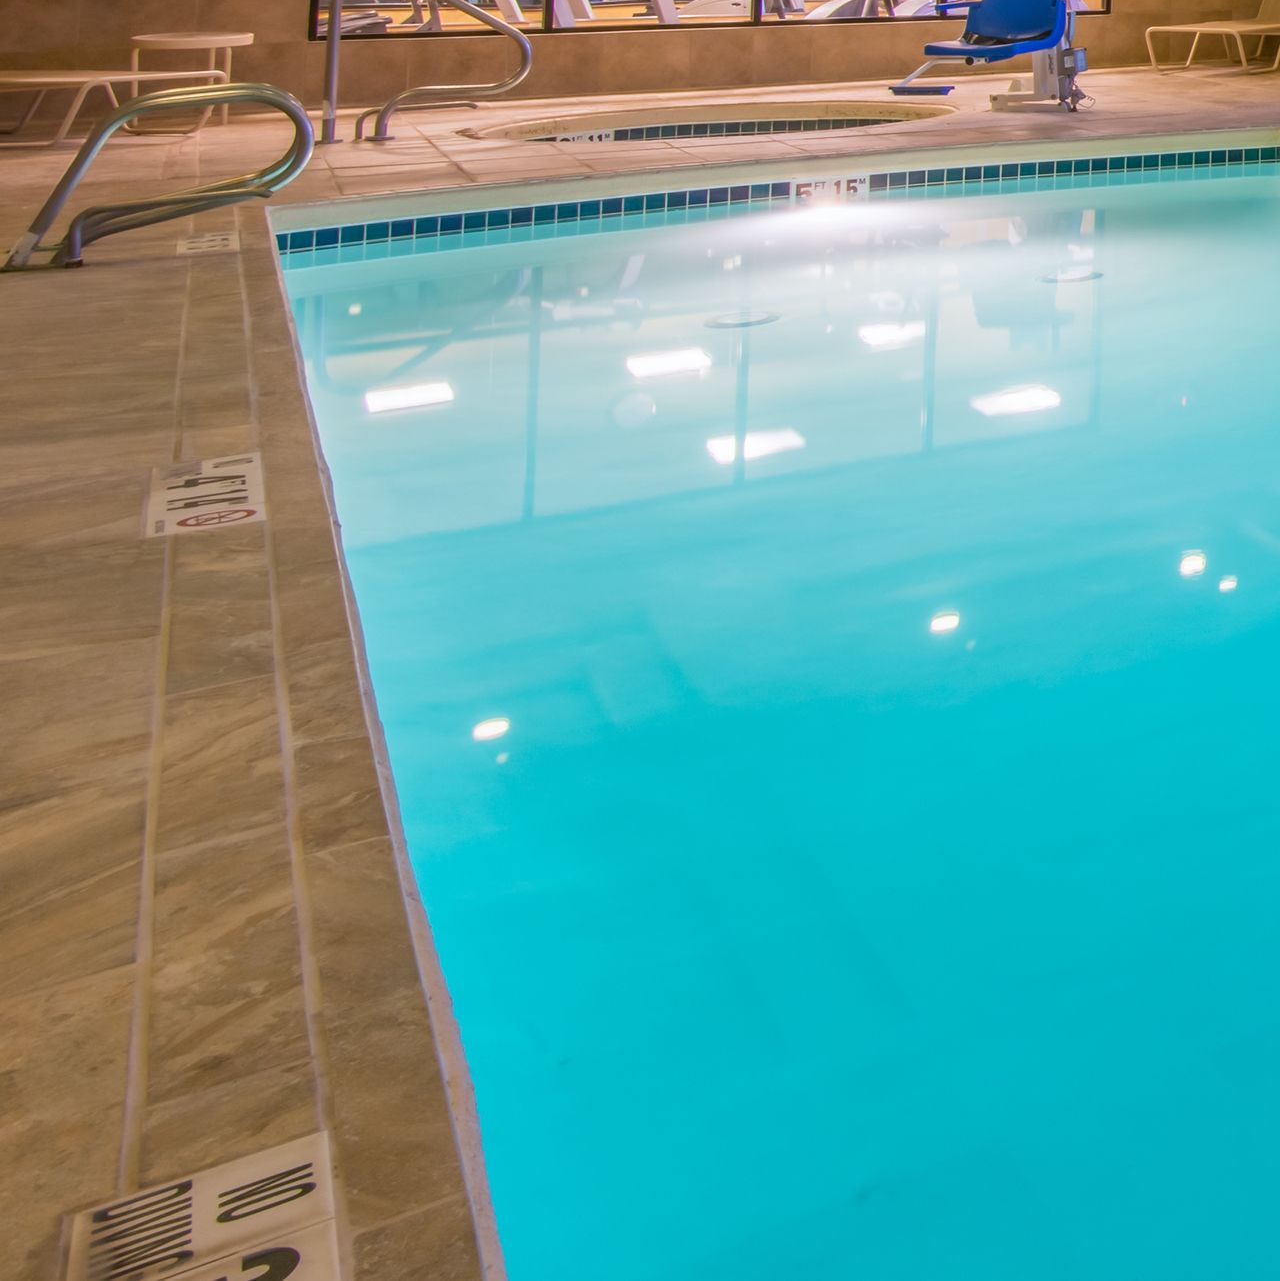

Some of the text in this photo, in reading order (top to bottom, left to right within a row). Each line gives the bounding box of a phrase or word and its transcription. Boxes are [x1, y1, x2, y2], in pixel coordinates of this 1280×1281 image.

[795, 182, 812, 197] 5
[814, 181, 826, 191] FT
[216, 1161, 317, 1224] NO
